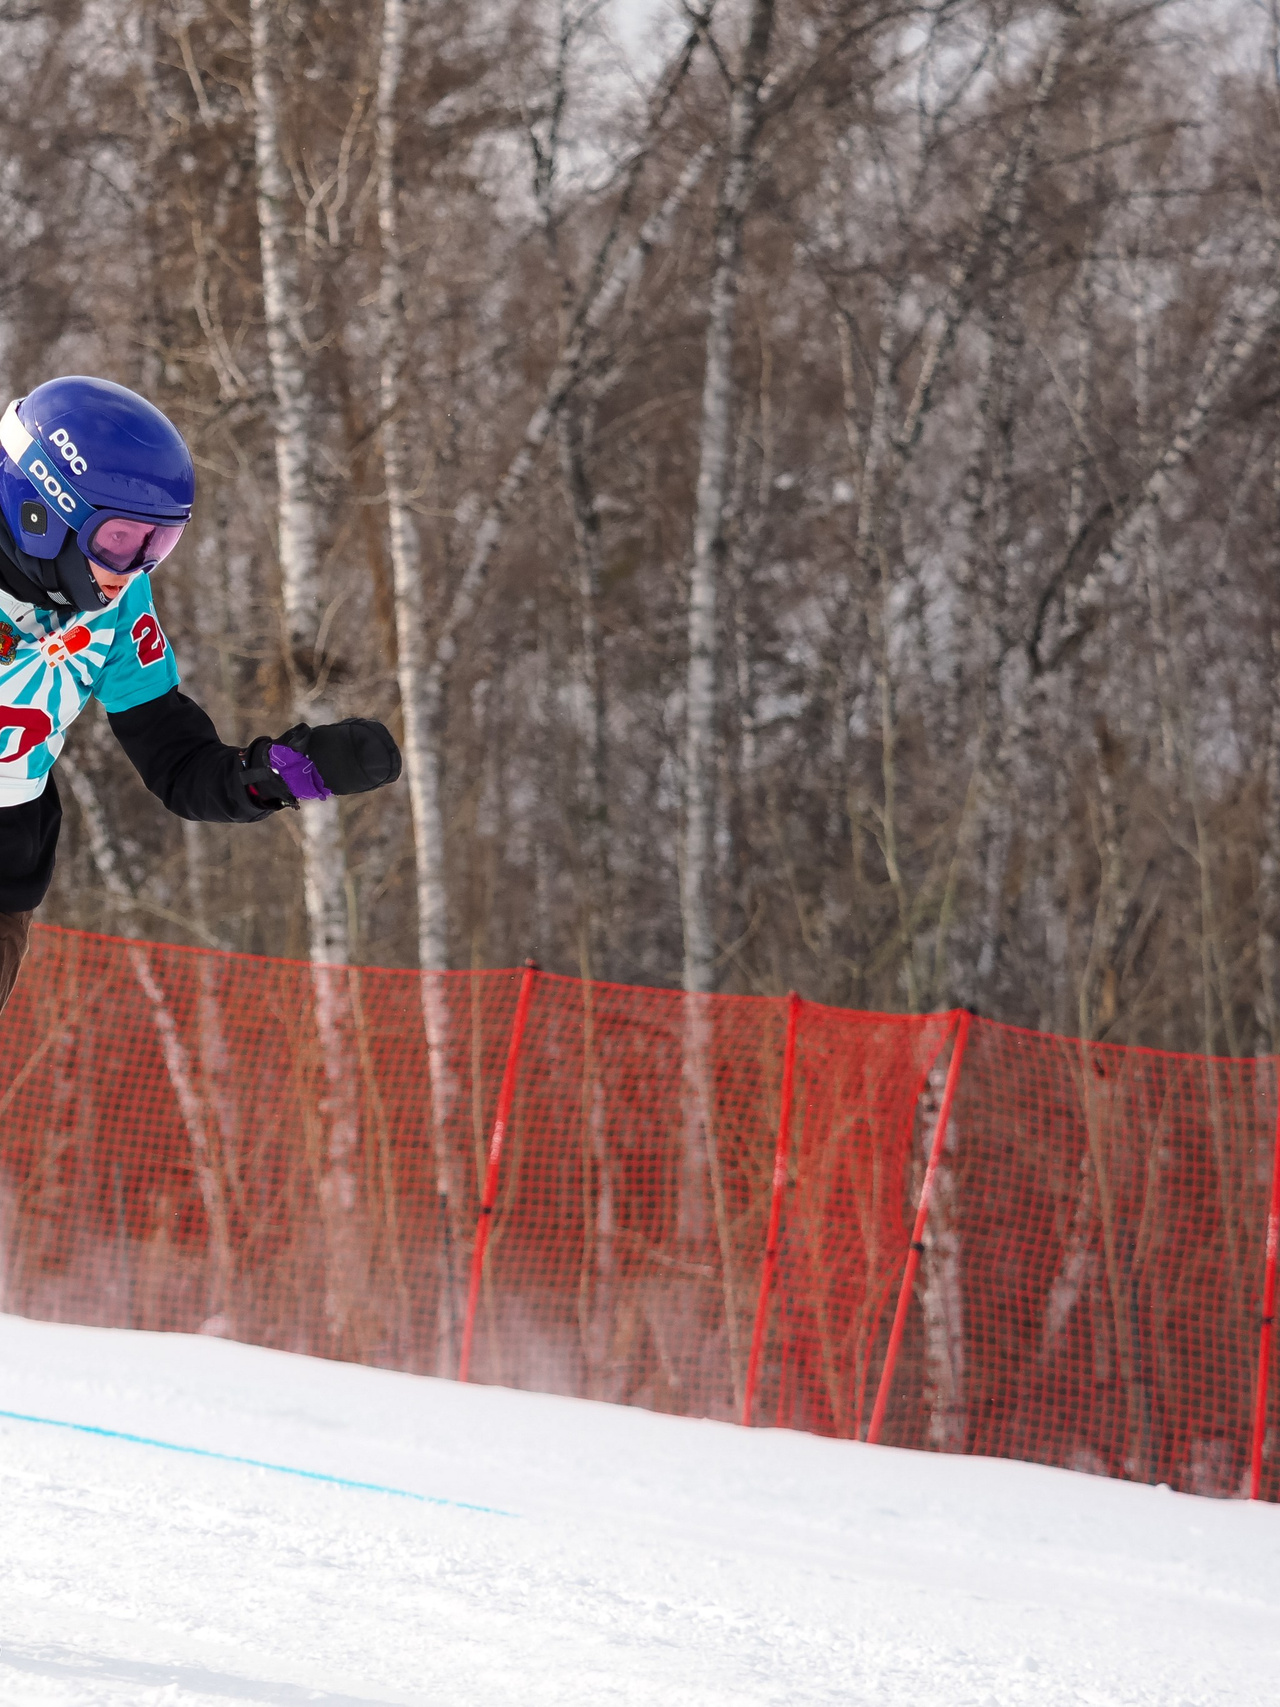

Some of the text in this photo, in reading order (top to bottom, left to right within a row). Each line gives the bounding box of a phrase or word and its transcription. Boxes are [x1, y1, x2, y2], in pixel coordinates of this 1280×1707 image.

[48, 427, 88, 476] POC
[28, 459, 77, 513] POC
[129, 612, 167, 669] 2
